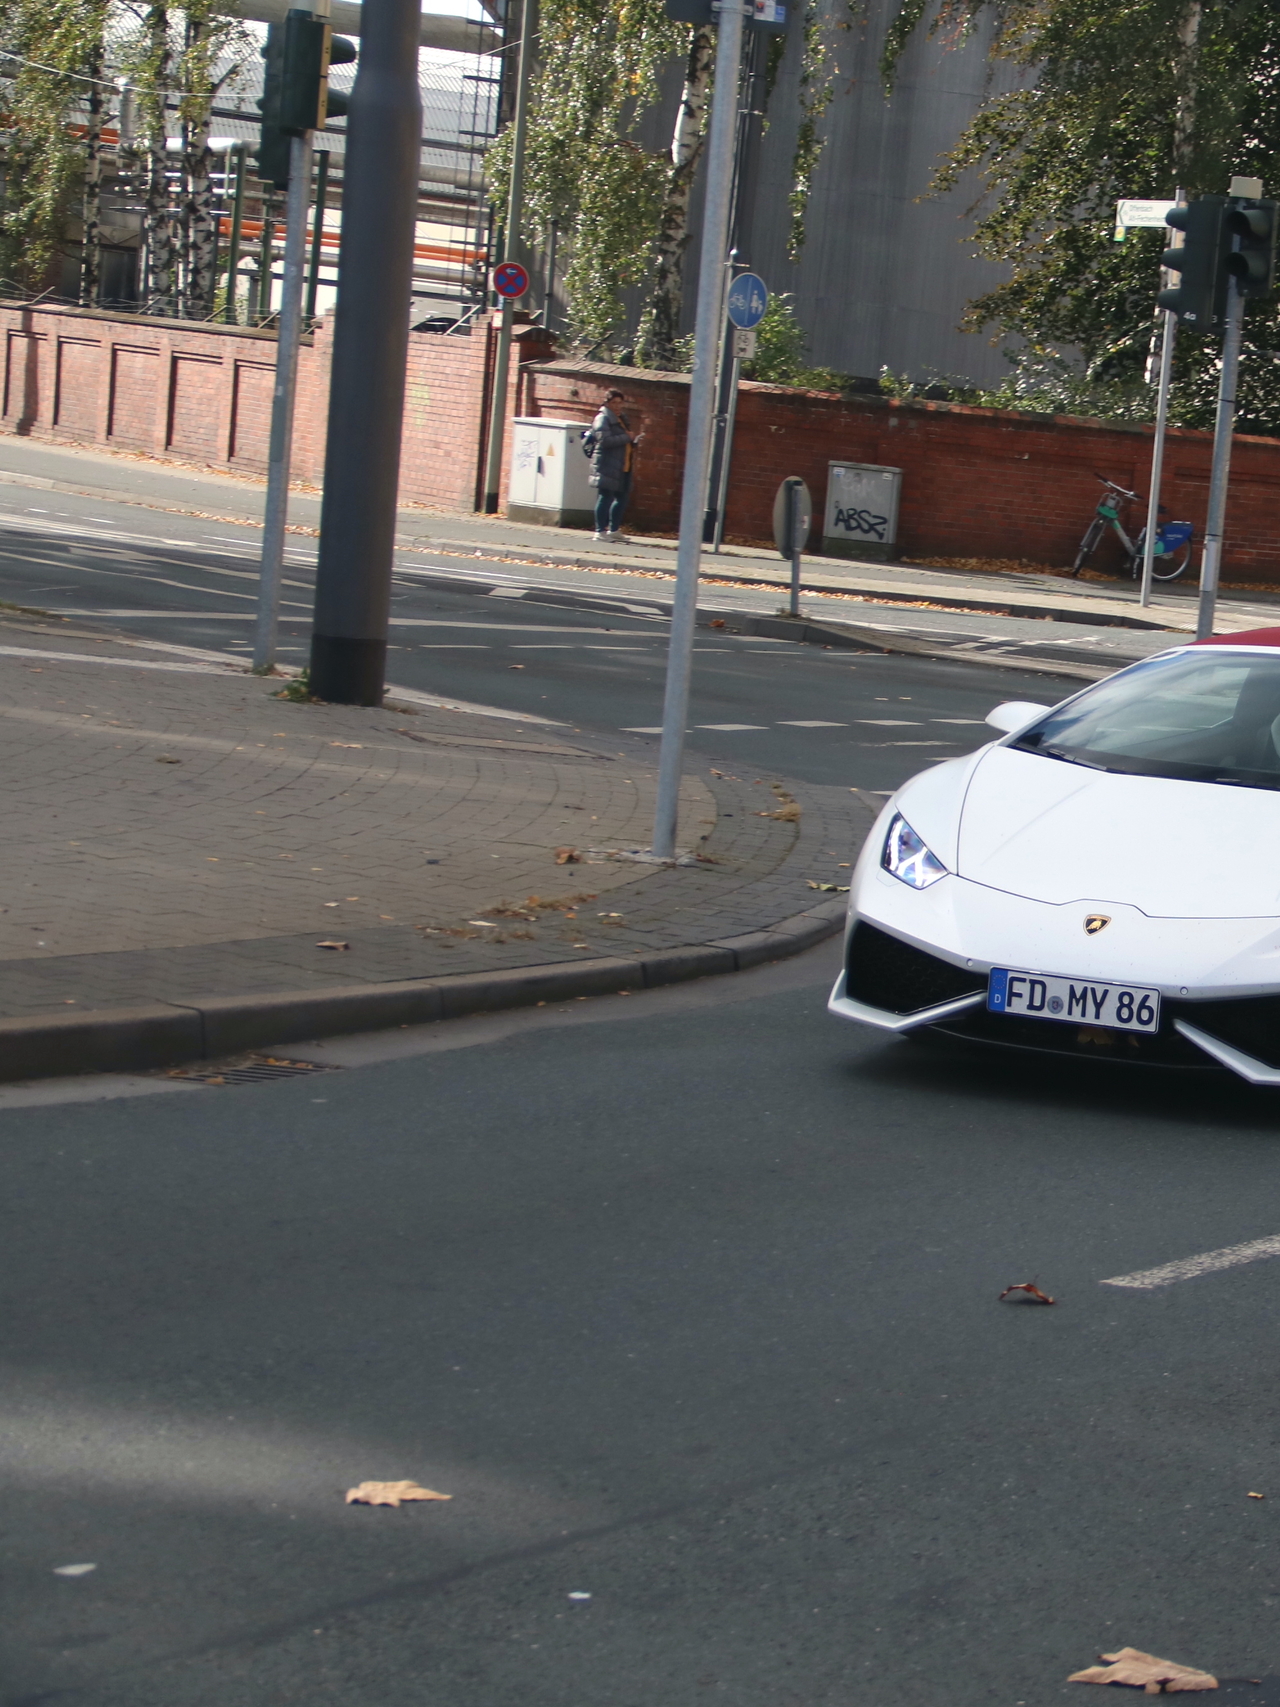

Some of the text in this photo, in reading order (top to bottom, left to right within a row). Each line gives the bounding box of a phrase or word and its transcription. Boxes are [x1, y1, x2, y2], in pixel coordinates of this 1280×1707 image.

[994, 993, 1001, 1003] D
[1006, 976, 1155, 1025] FD MY 86
